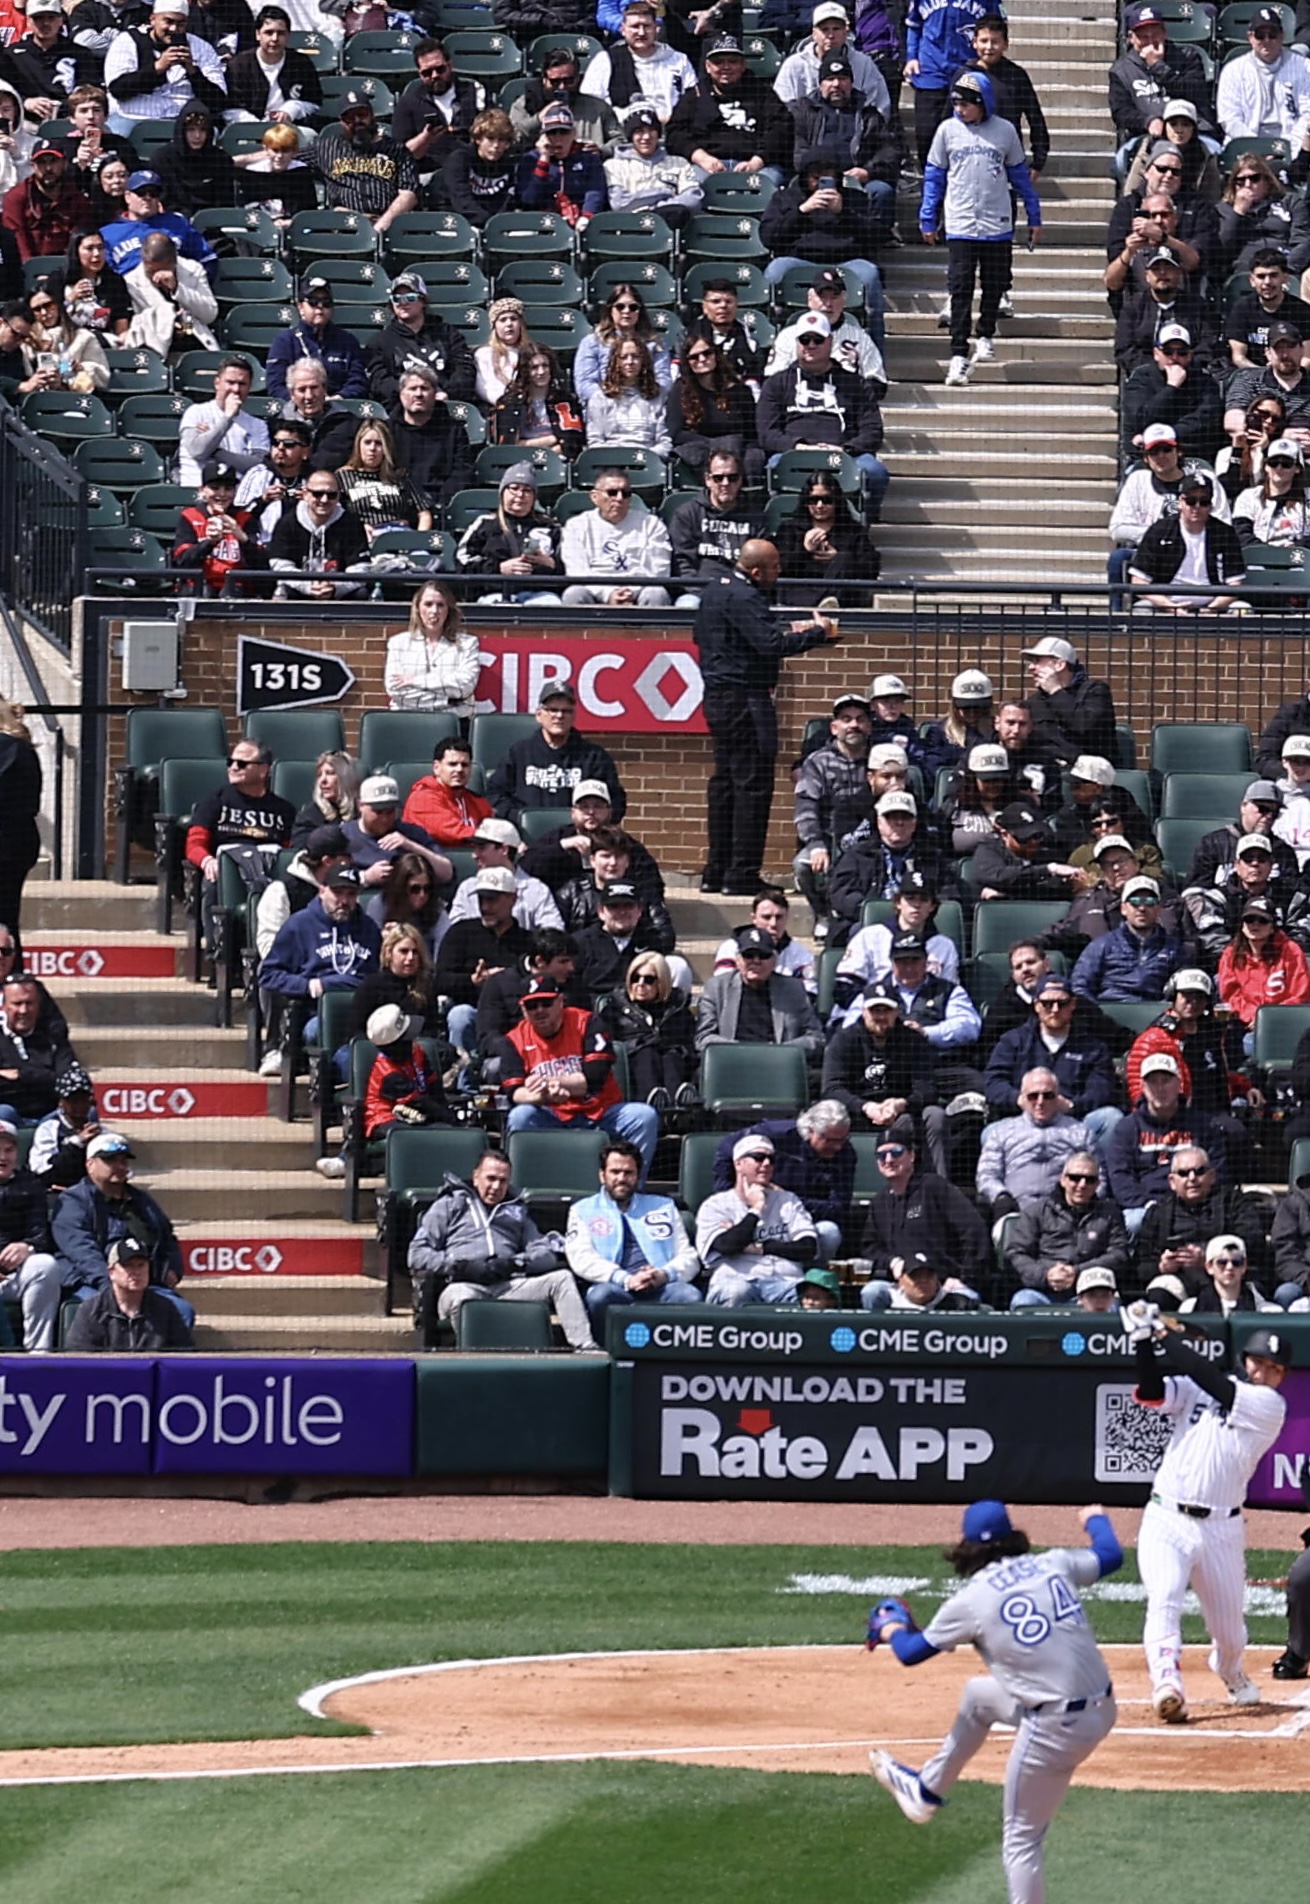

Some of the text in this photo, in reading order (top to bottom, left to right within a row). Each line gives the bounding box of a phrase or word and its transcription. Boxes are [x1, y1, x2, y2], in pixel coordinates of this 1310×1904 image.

[555, 402, 583, 432] L
[250, 663, 322, 691] 131S
[103, 1088, 166, 1113] CIBC
[189, 1247, 252, 1272] CIBC
[653, 1325, 803, 1354] CME Group
[859, 1328, 1008, 1358] CME Group
[661, 1375, 967, 1404] DOWNLOAD THE
[85, 1374, 344, 1446] mobile
[660, 1407, 995, 1481] Rate APP
[1000, 1573, 1087, 1648] 84
